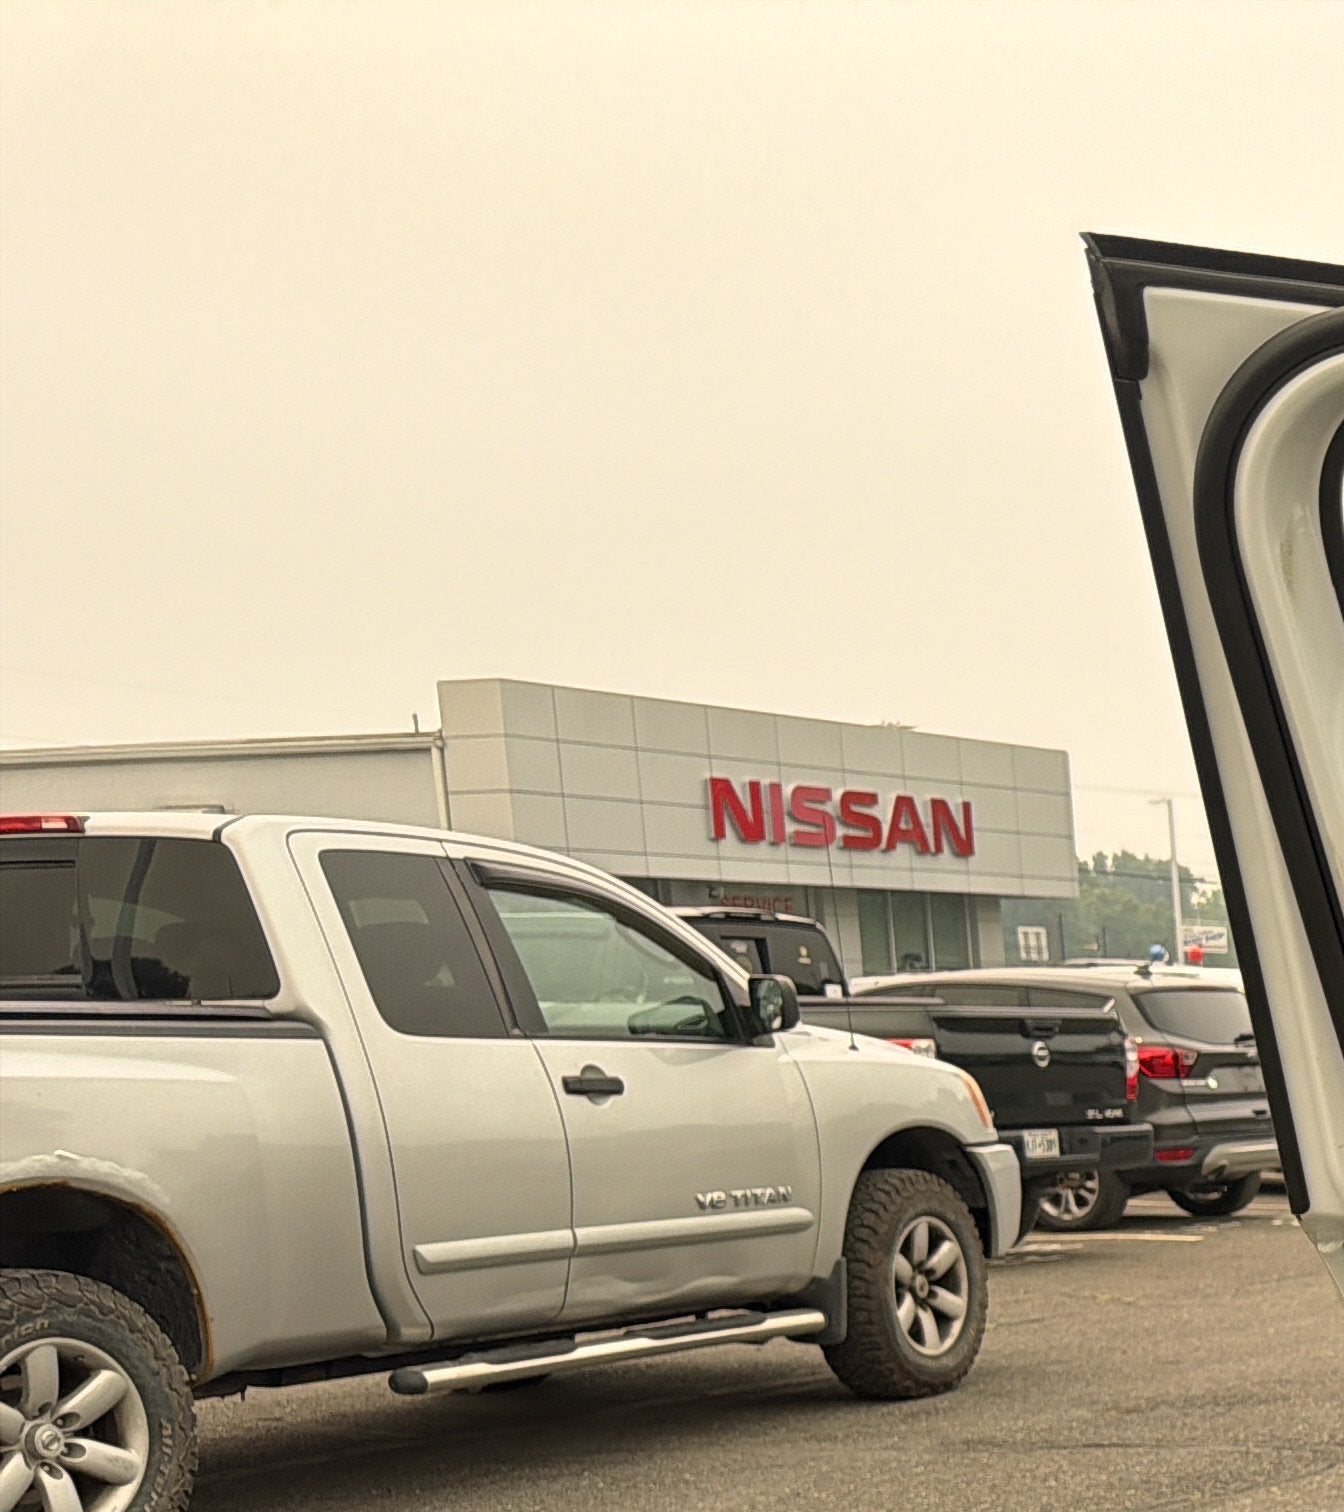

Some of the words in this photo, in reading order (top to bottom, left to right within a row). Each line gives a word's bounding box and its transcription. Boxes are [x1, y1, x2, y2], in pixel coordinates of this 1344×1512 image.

[708, 776, 975, 857] NISSAN
[720, 895, 793, 913] SERVICE
[730, 1184, 793, 1207] TITAN
